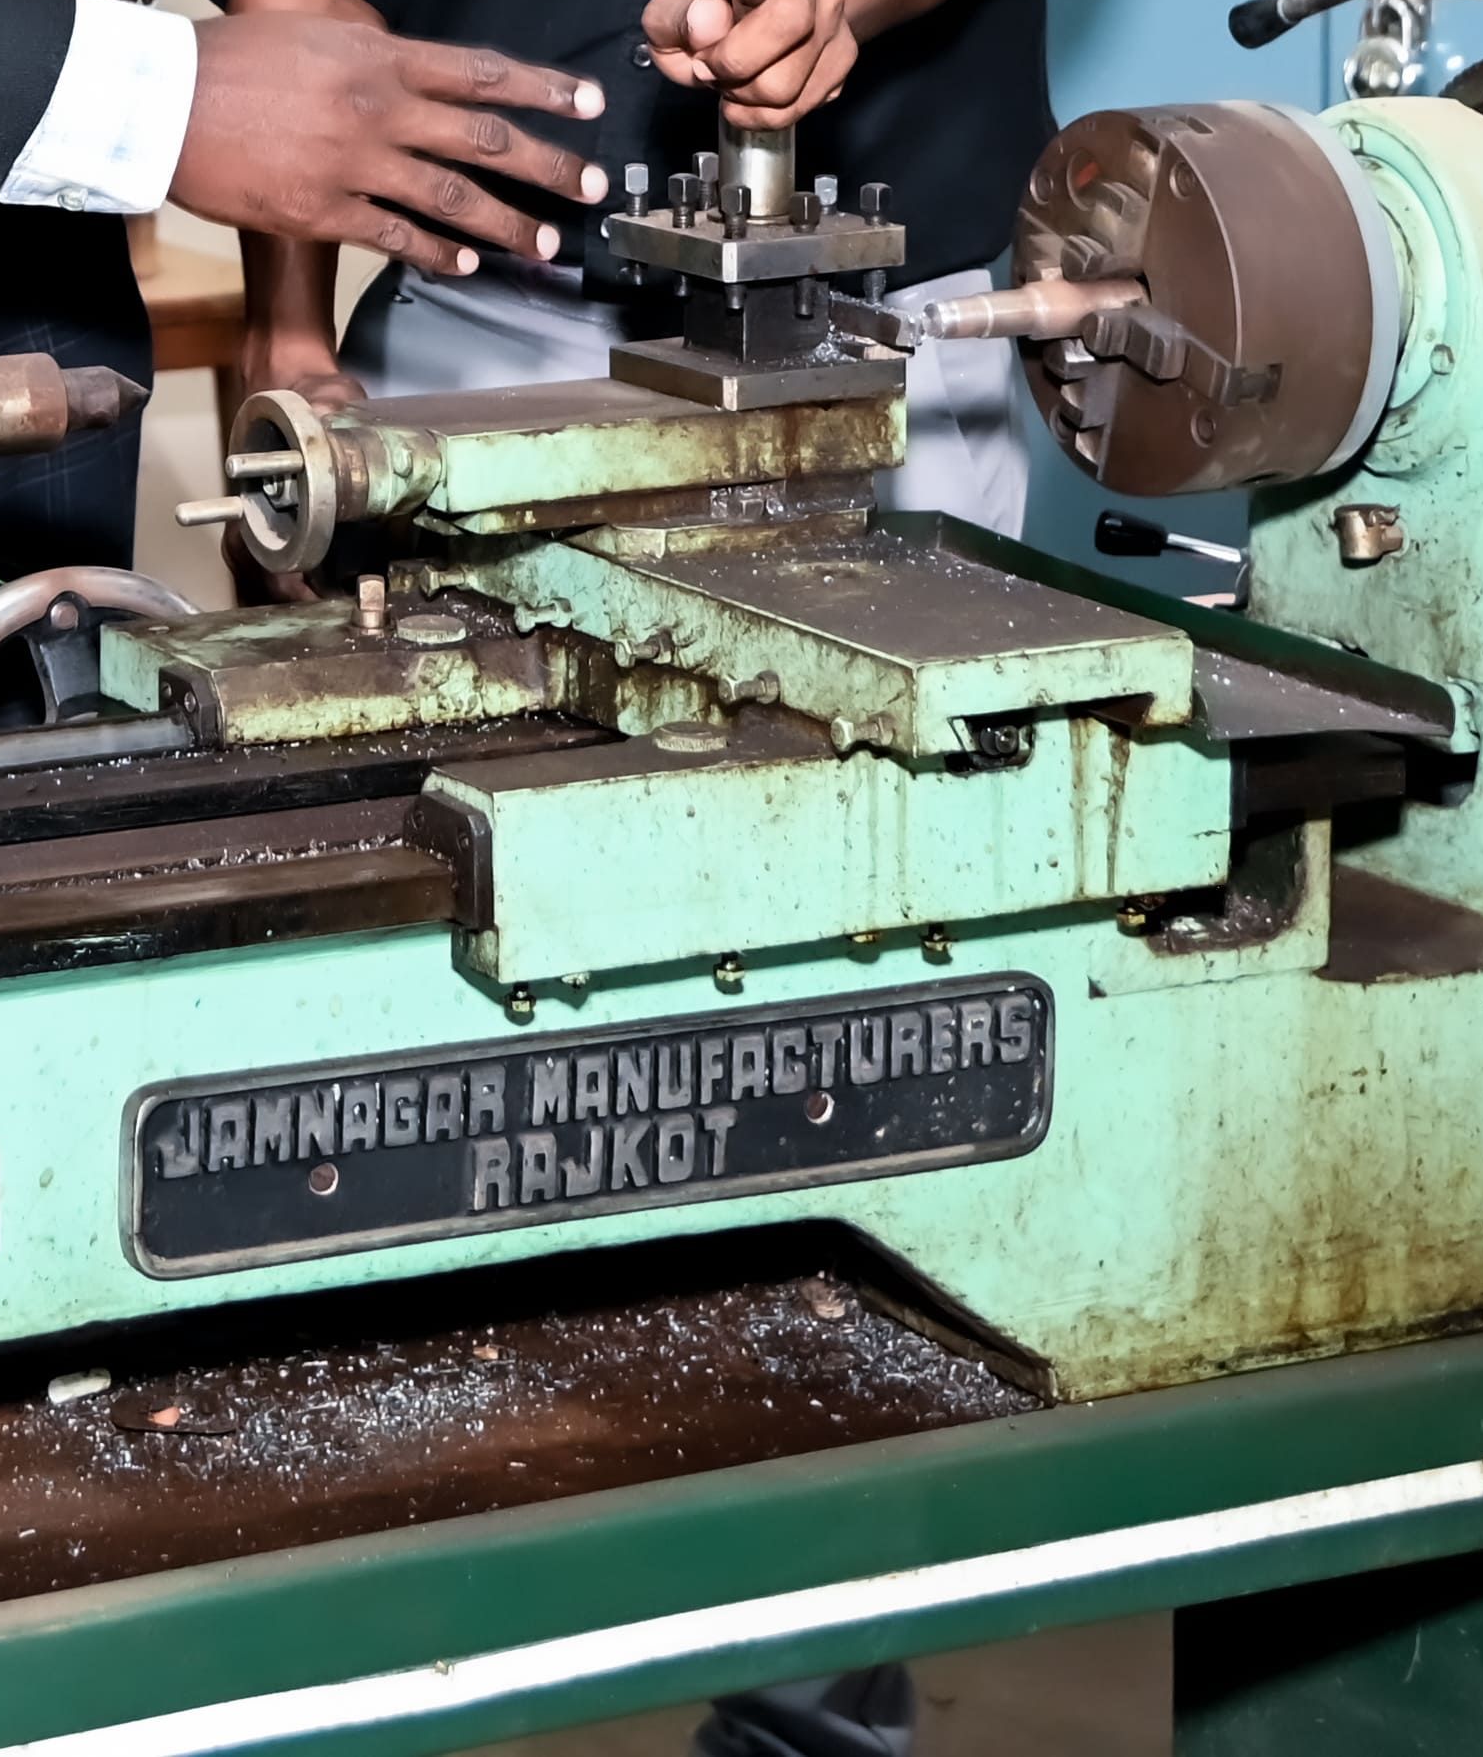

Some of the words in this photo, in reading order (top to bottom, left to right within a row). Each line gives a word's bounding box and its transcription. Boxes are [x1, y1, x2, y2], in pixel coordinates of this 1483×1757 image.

[154, 1061, 506, 1179] JAMNAGAR
[530, 994, 1033, 1127] MANUFACTURERS
[471, 1107, 738, 1212] RAJKOT
